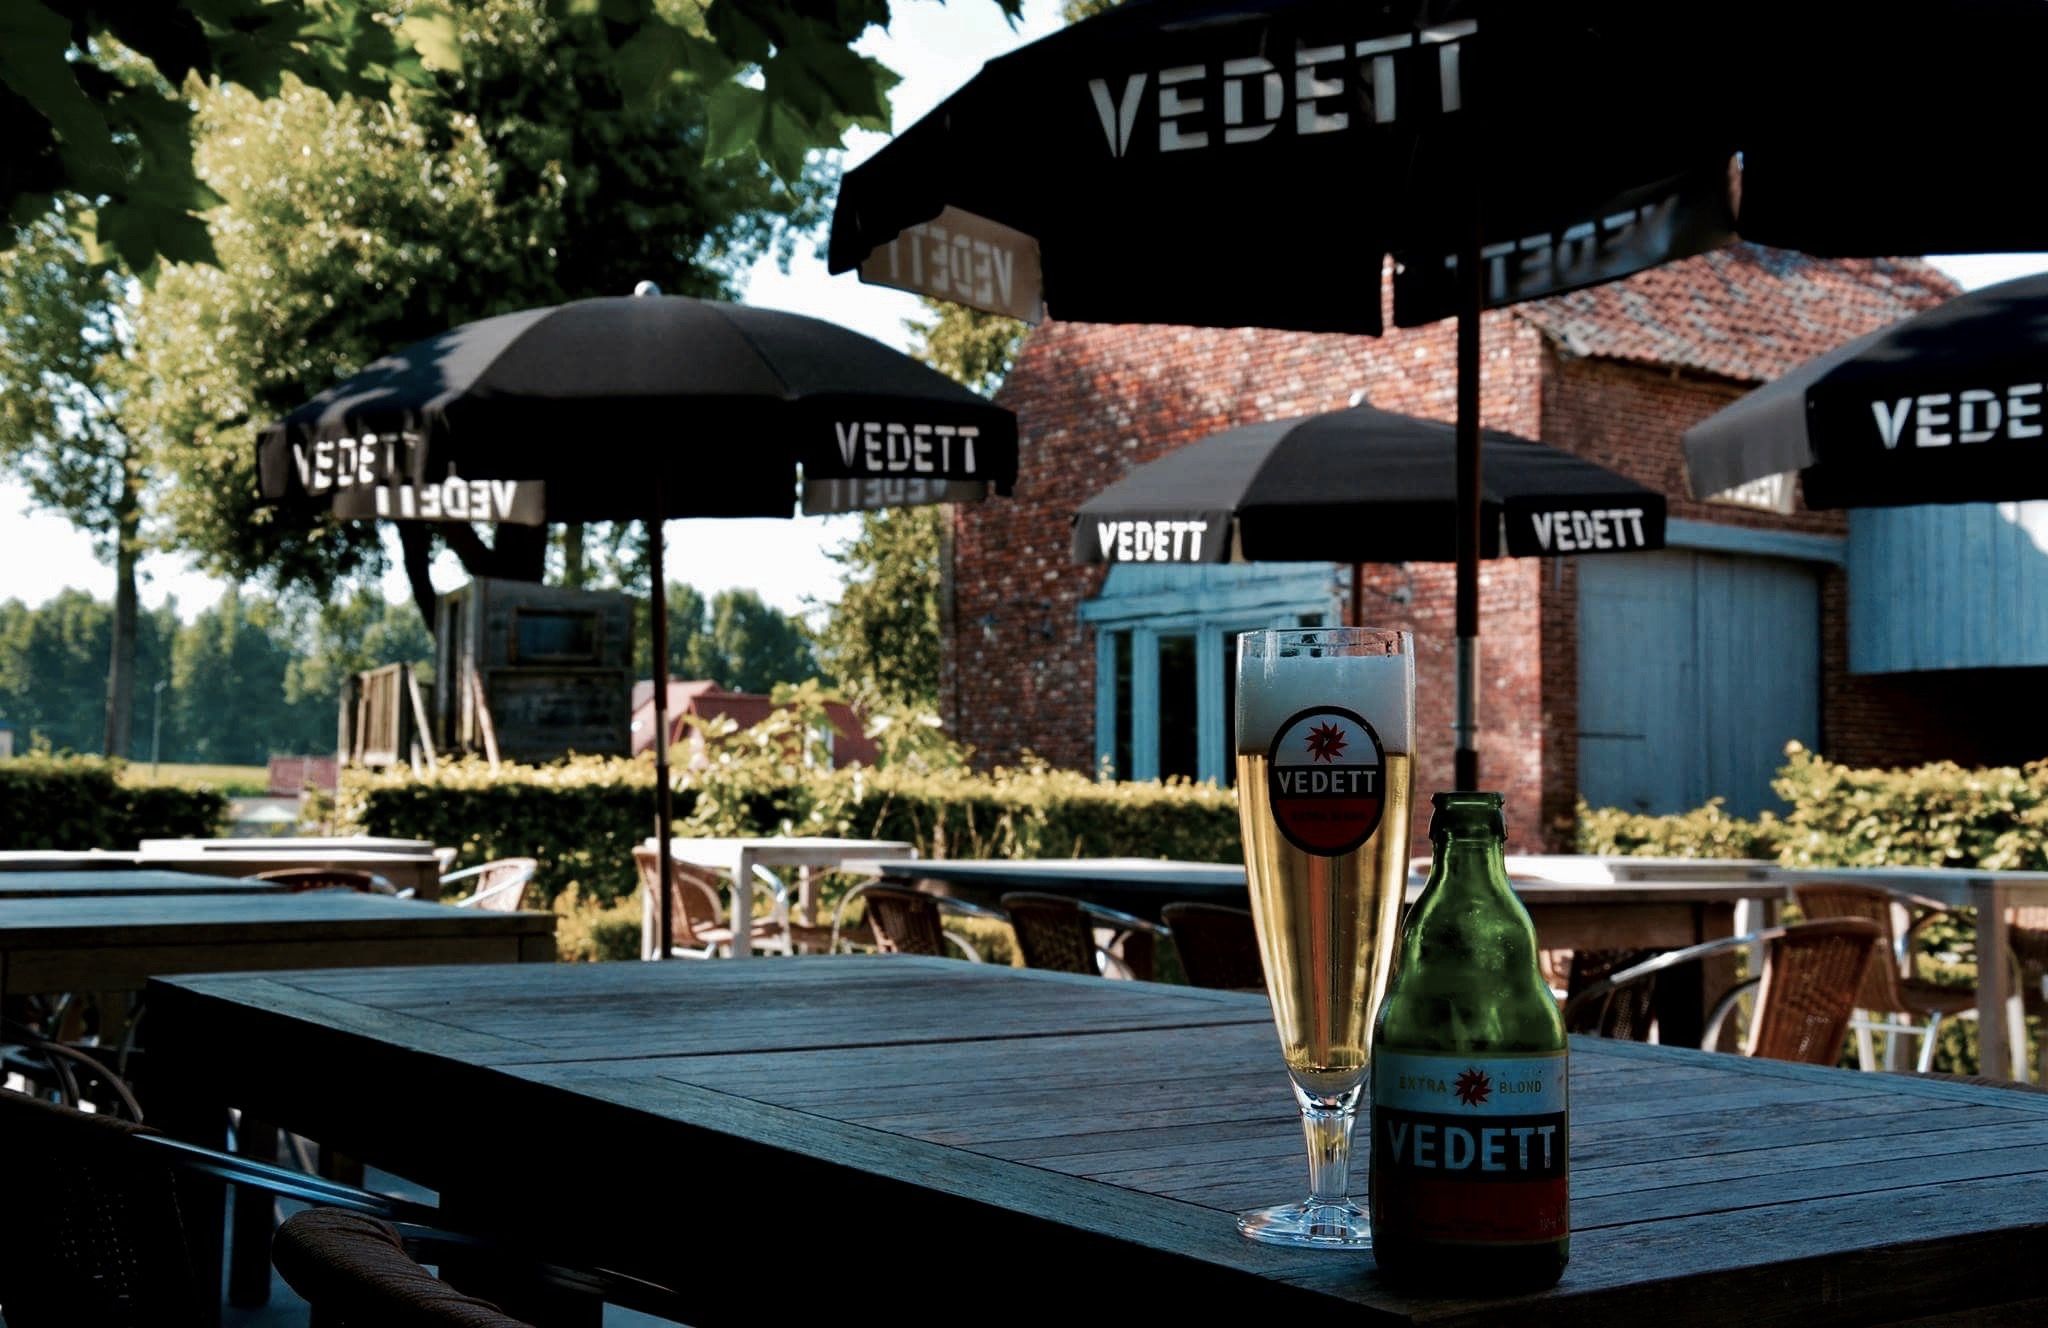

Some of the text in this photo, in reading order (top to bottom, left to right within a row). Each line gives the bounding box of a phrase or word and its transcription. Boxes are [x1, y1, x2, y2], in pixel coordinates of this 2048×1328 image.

[1088, 18, 1479, 158] VEDETT
[835, 421, 980, 473] VEDETT
[1097, 520, 1208, 562] VEDETT
[1531, 507, 1646, 552] VEDETT
[1276, 769, 1377, 795] VEDETT
[1399, 1074, 1542, 1095] EXTRA BLOND
[1386, 1119, 1556, 1172] VEDETT
